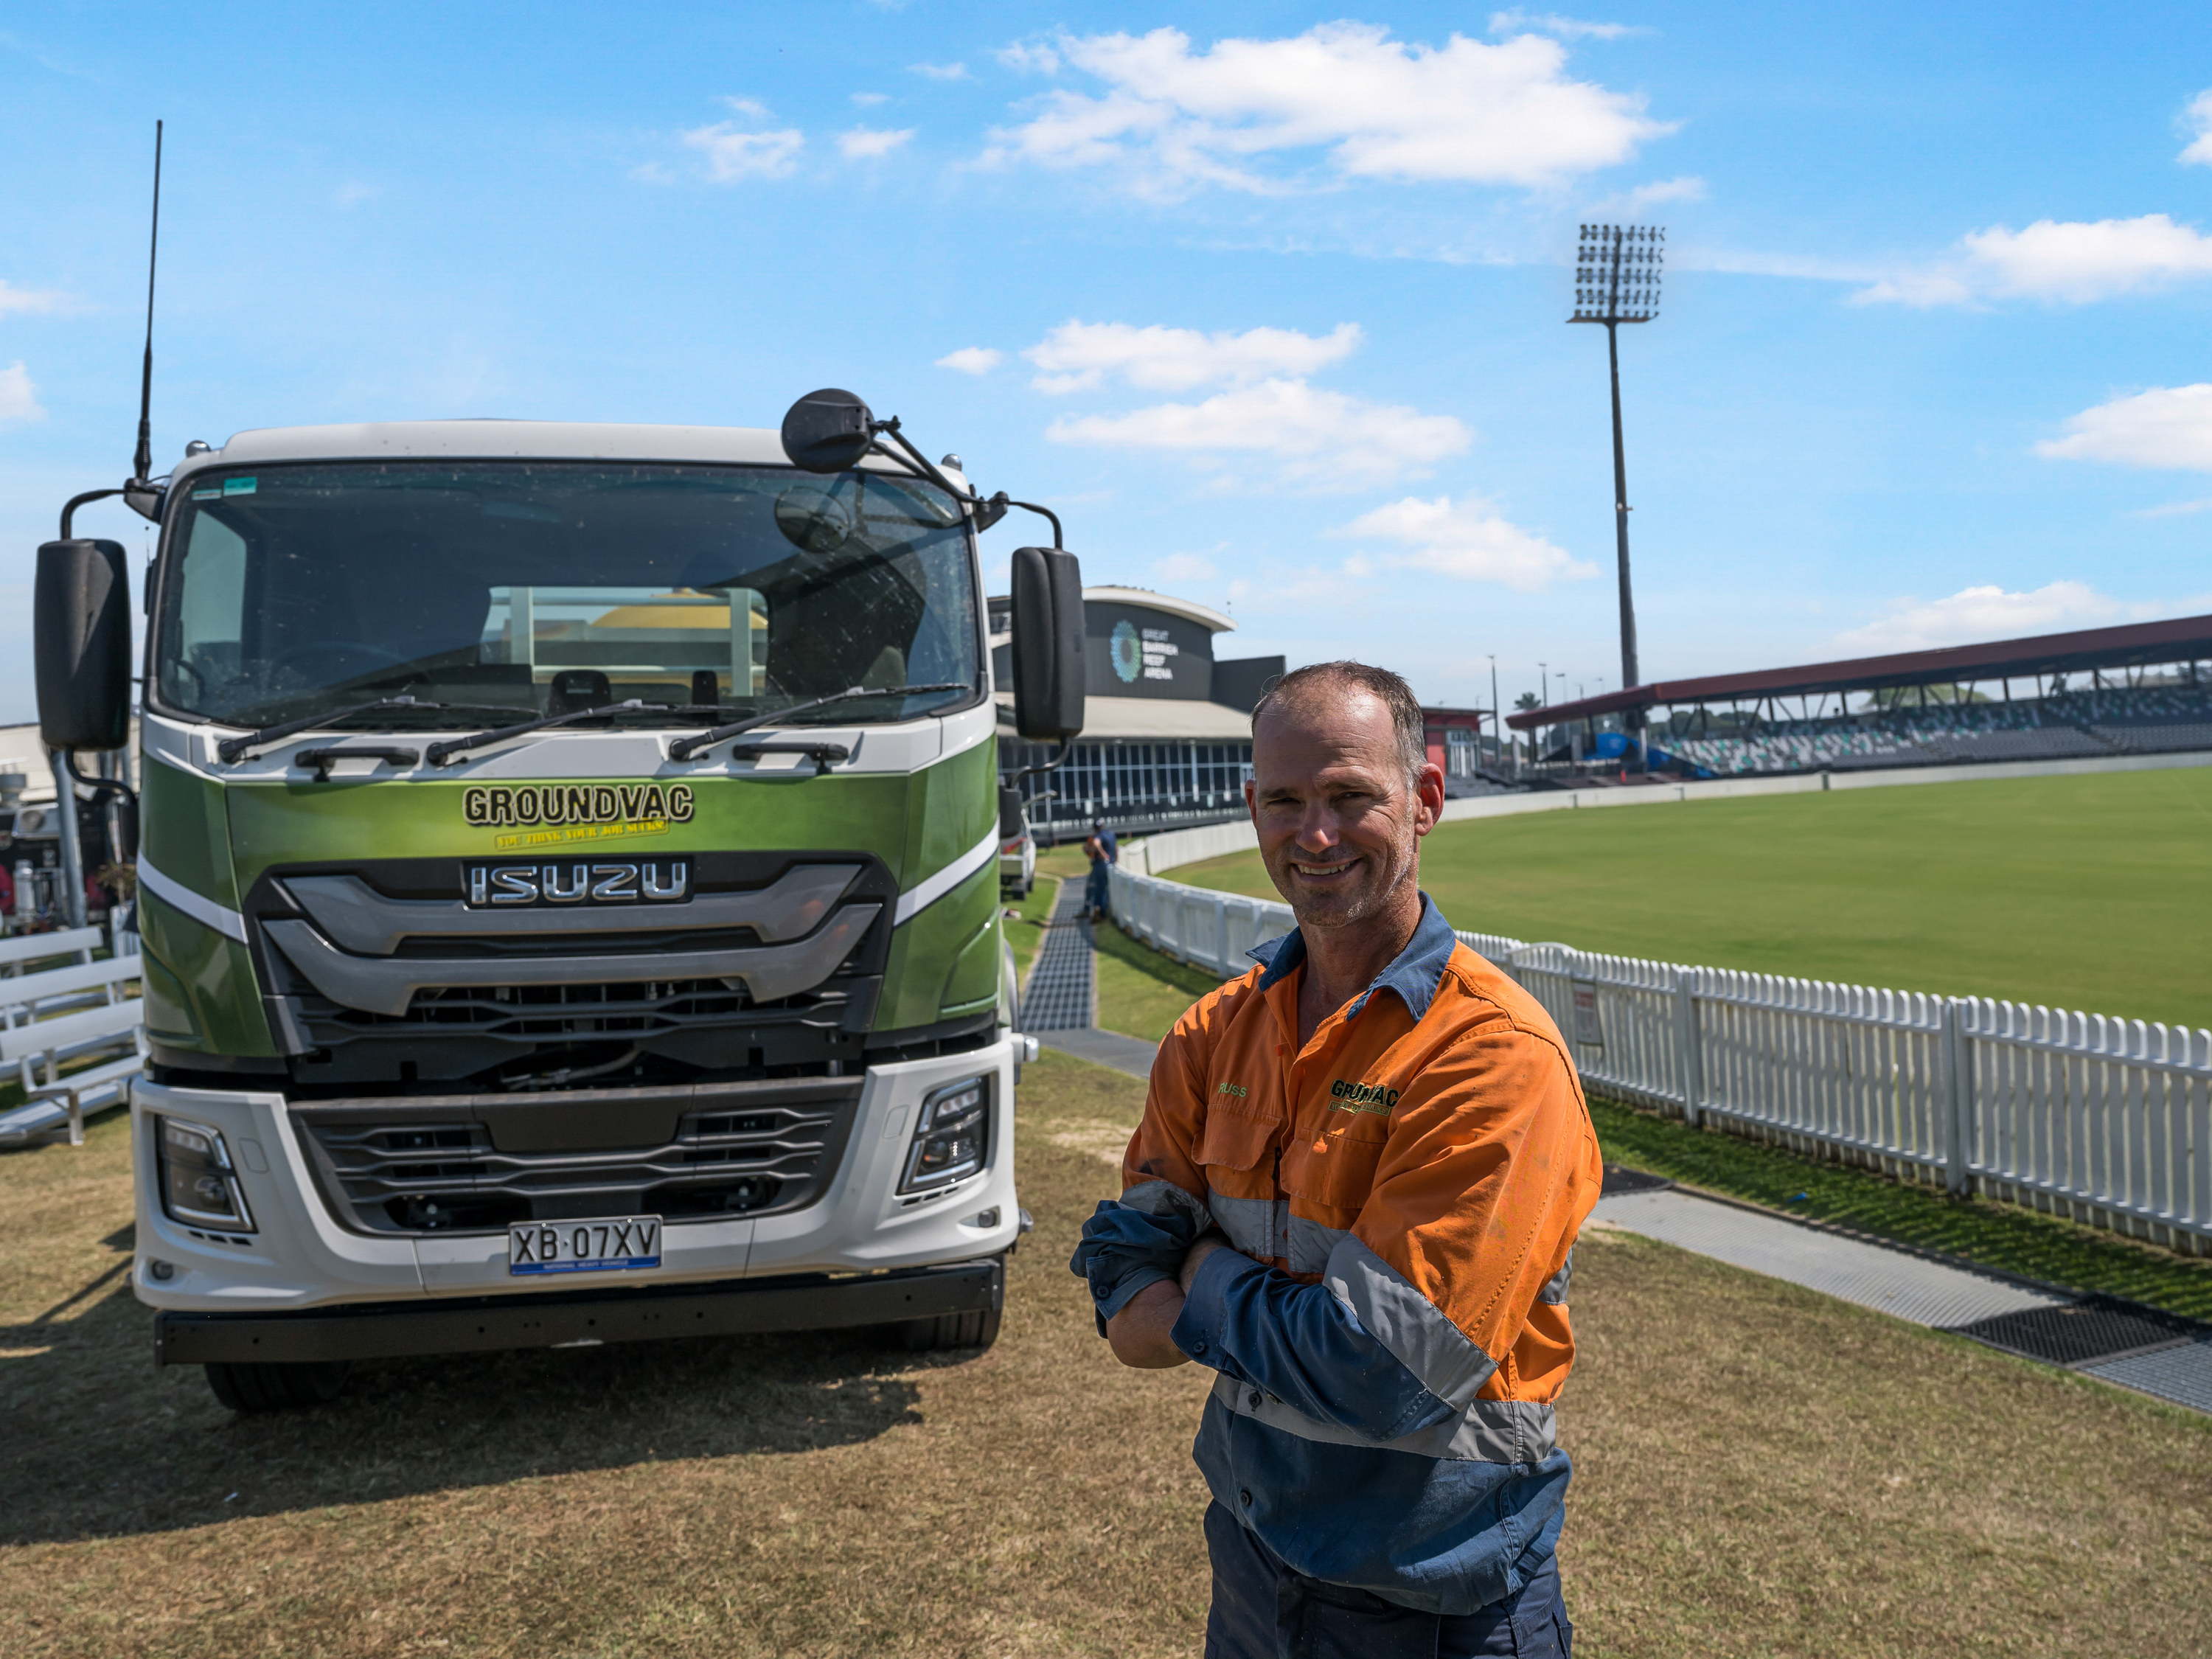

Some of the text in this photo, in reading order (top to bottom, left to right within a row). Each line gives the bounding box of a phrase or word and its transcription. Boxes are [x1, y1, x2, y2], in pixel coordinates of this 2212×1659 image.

[463, 784, 693, 824] GROUNDVAC
[470, 862, 686, 905] ISUZU
[1218, 1082, 1248, 1097] RUSS
